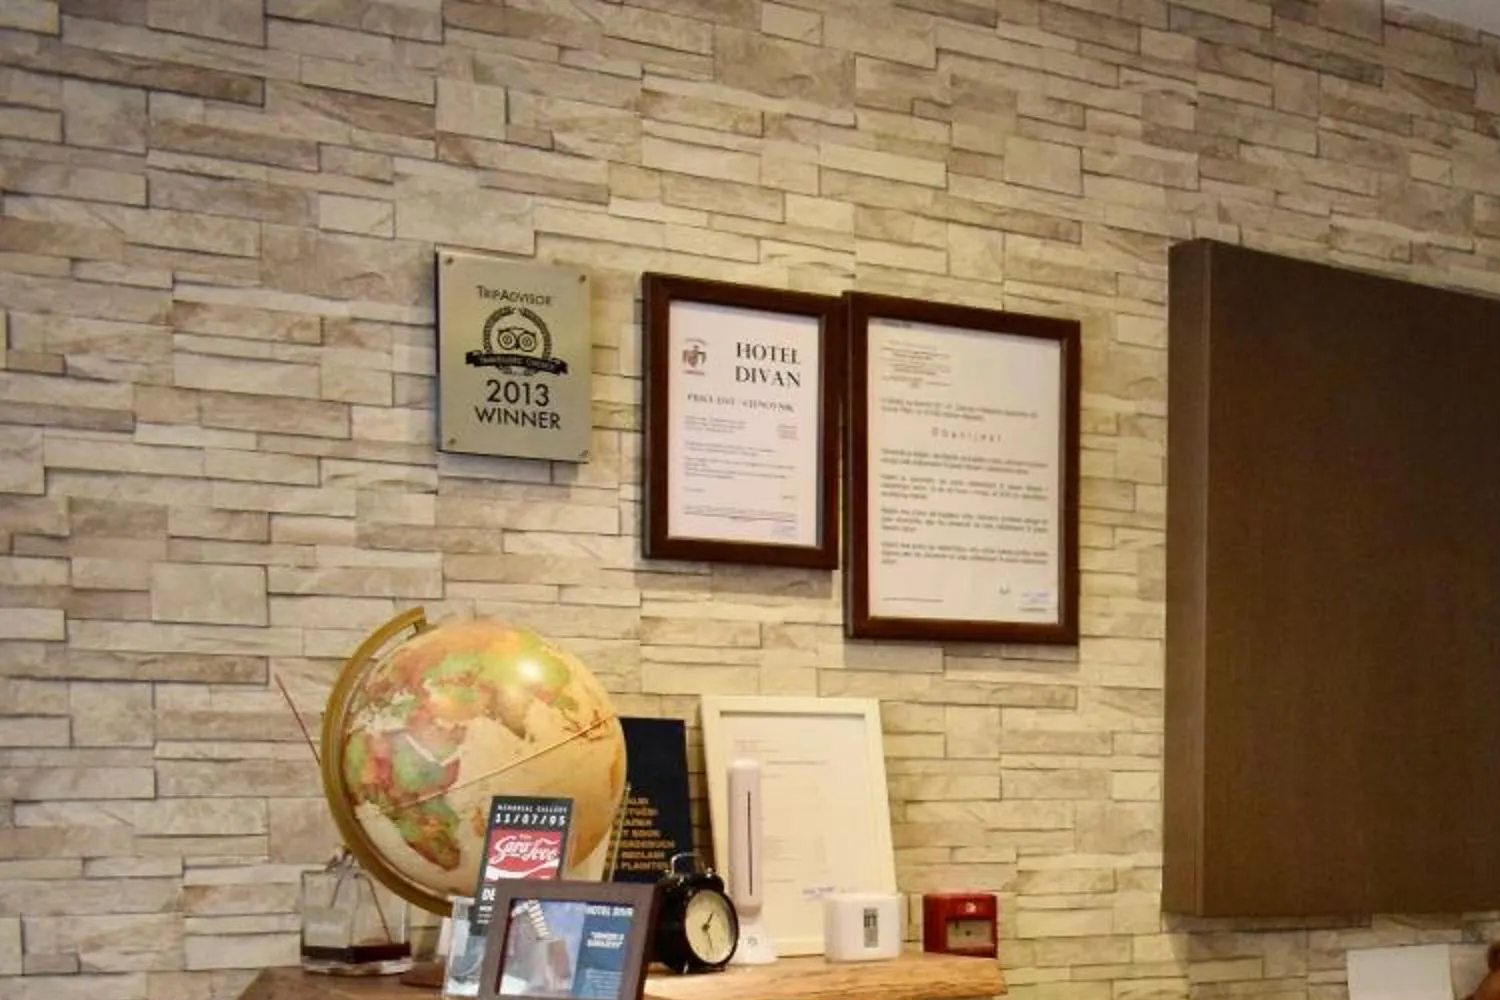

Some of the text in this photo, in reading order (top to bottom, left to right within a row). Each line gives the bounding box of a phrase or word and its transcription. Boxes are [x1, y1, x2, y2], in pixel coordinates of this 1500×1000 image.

[736, 341, 800, 364] HOTEL
[735, 365, 801, 387] DIVAN
[486, 379, 550, 406] 2013
[474, 406, 561, 429] WINNER
[495, 813, 565, 826] 11/07/95
